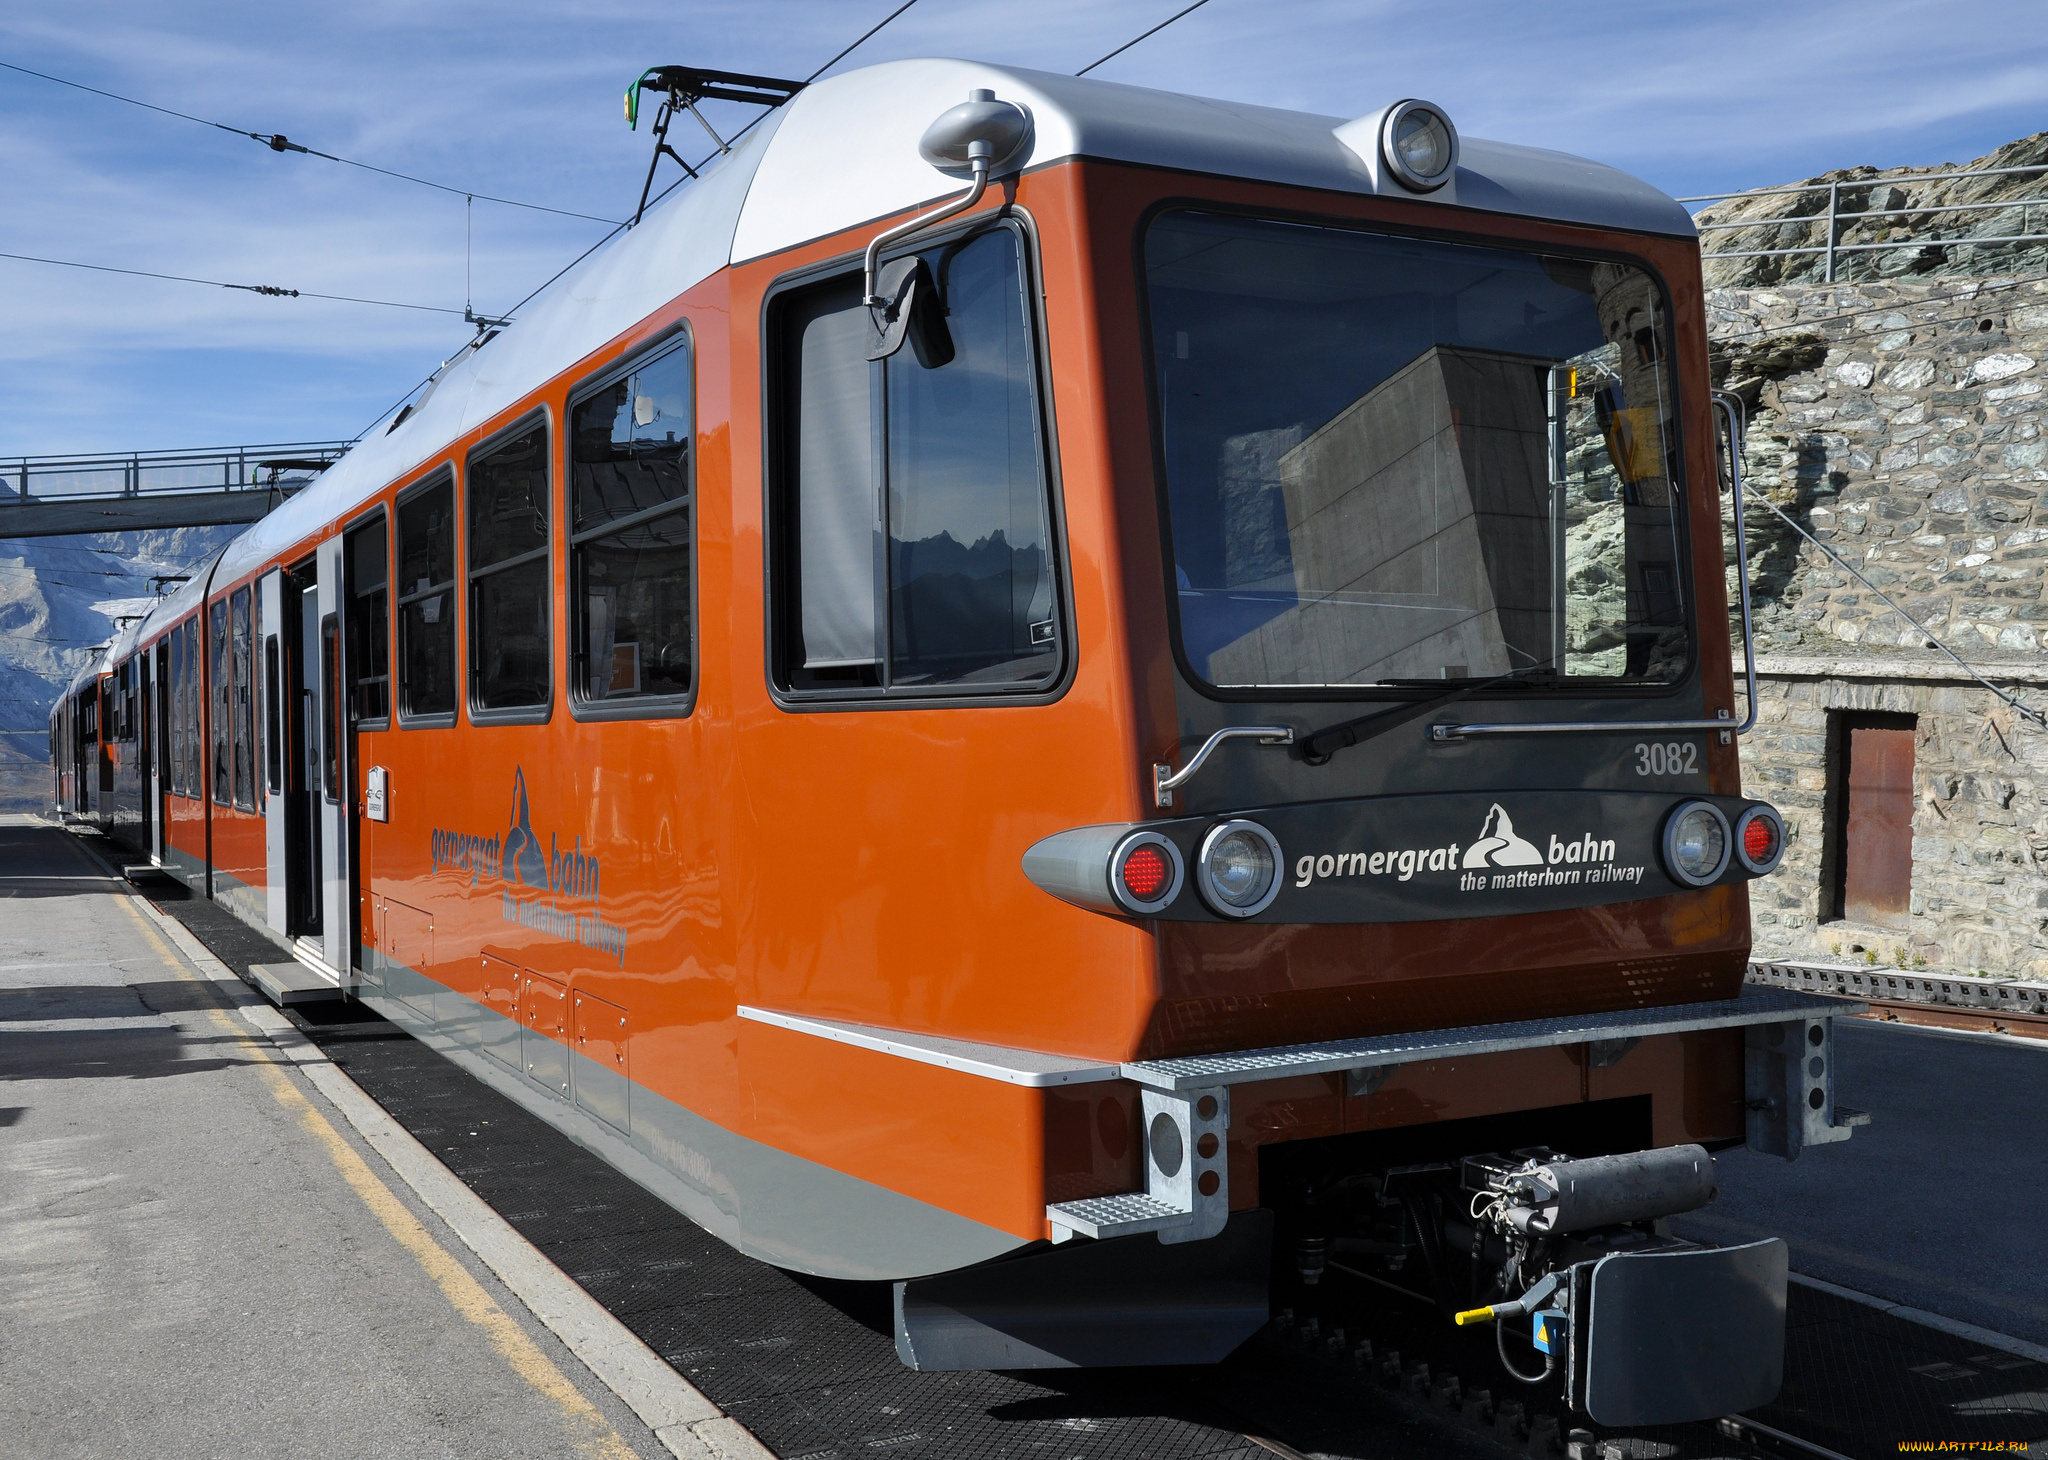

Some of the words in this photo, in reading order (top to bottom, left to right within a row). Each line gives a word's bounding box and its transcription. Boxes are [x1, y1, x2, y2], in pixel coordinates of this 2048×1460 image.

[1634, 742, 1699, 776] 3082
[432, 827, 501, 888] gornergrat
[552, 831, 600, 904] bahn
[1295, 842, 1460, 888] gornergrat
[1548, 832, 1616, 865] bahn
[1460, 871, 1487, 892] the
[1491, 866, 1581, 890] matterhorn
[1585, 863, 1645, 885] railway
[503, 886, 517, 924] the
[519, 898, 576, 944] matterhorn
[579, 908, 628, 970] railway
[688, 1147, 712, 1189] 3082
